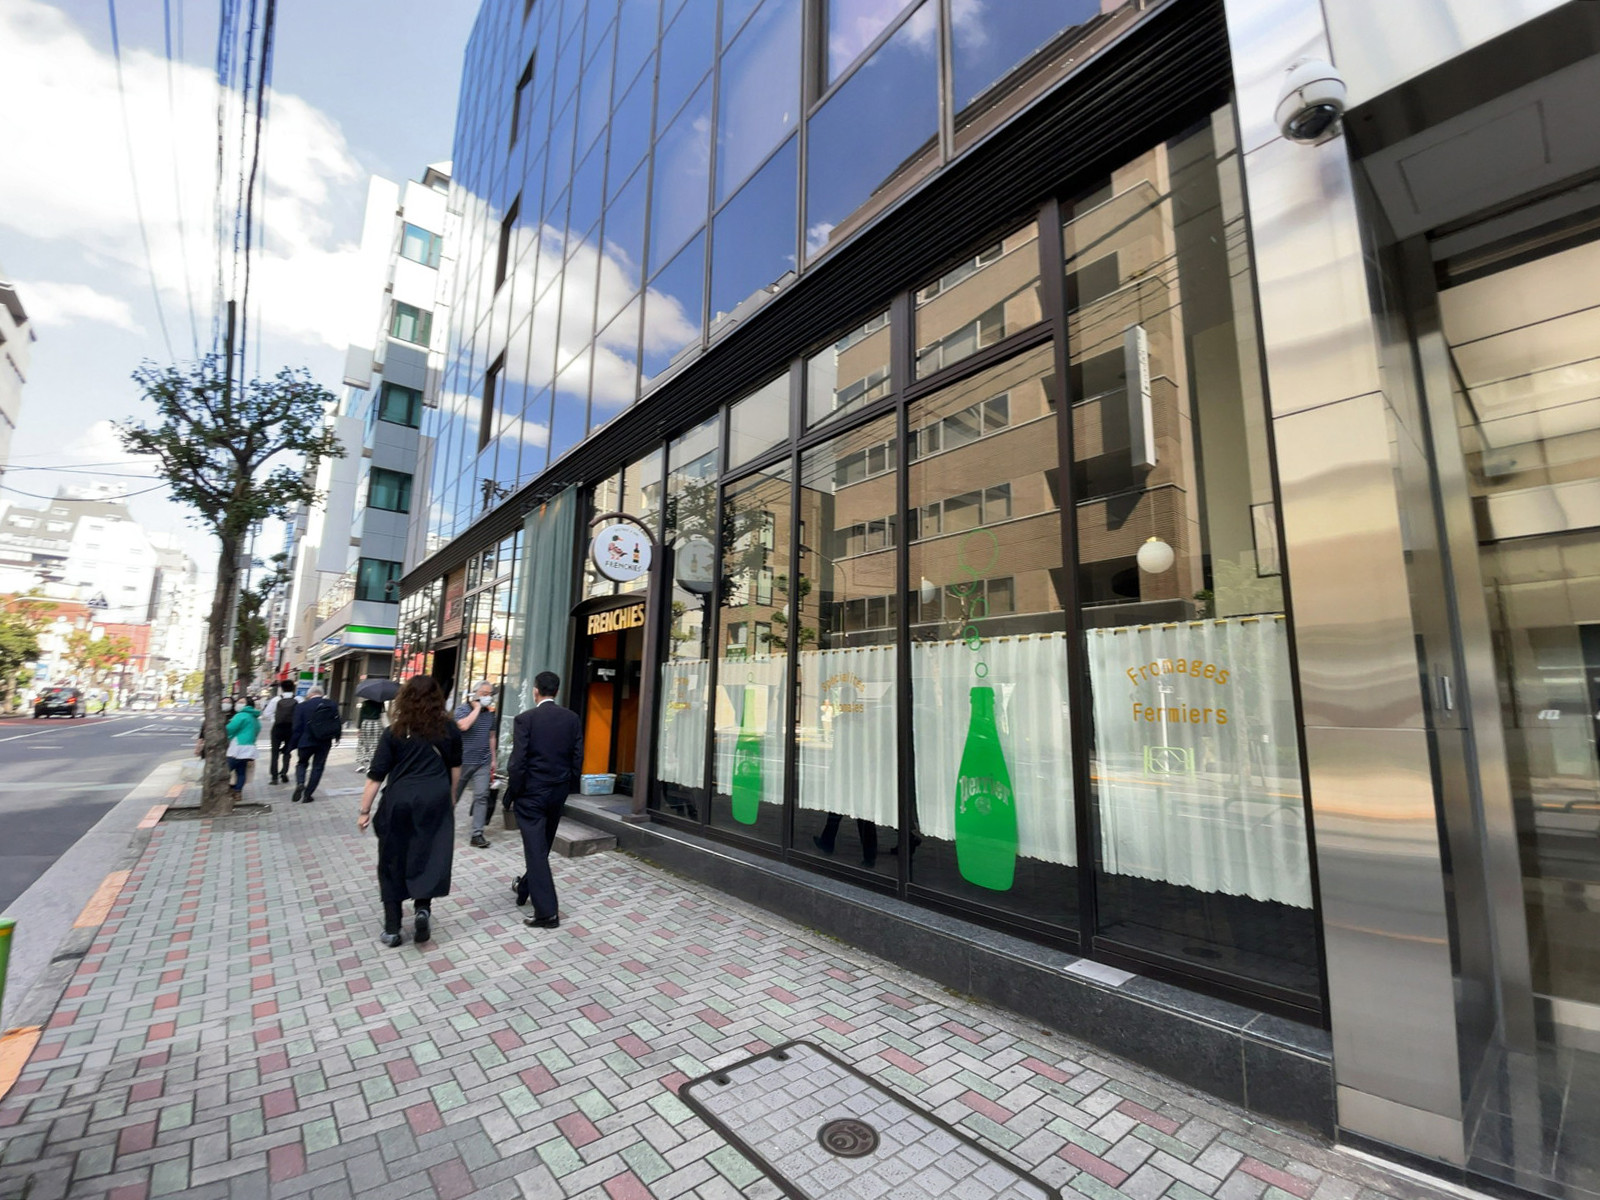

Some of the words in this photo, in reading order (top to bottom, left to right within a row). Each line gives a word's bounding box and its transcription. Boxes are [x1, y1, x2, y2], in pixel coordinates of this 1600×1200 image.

[587, 603, 646, 635] FRENCHIES
[1126, 658, 1230, 686] Fromages
[1133, 703, 1229, 725] Fermiers
